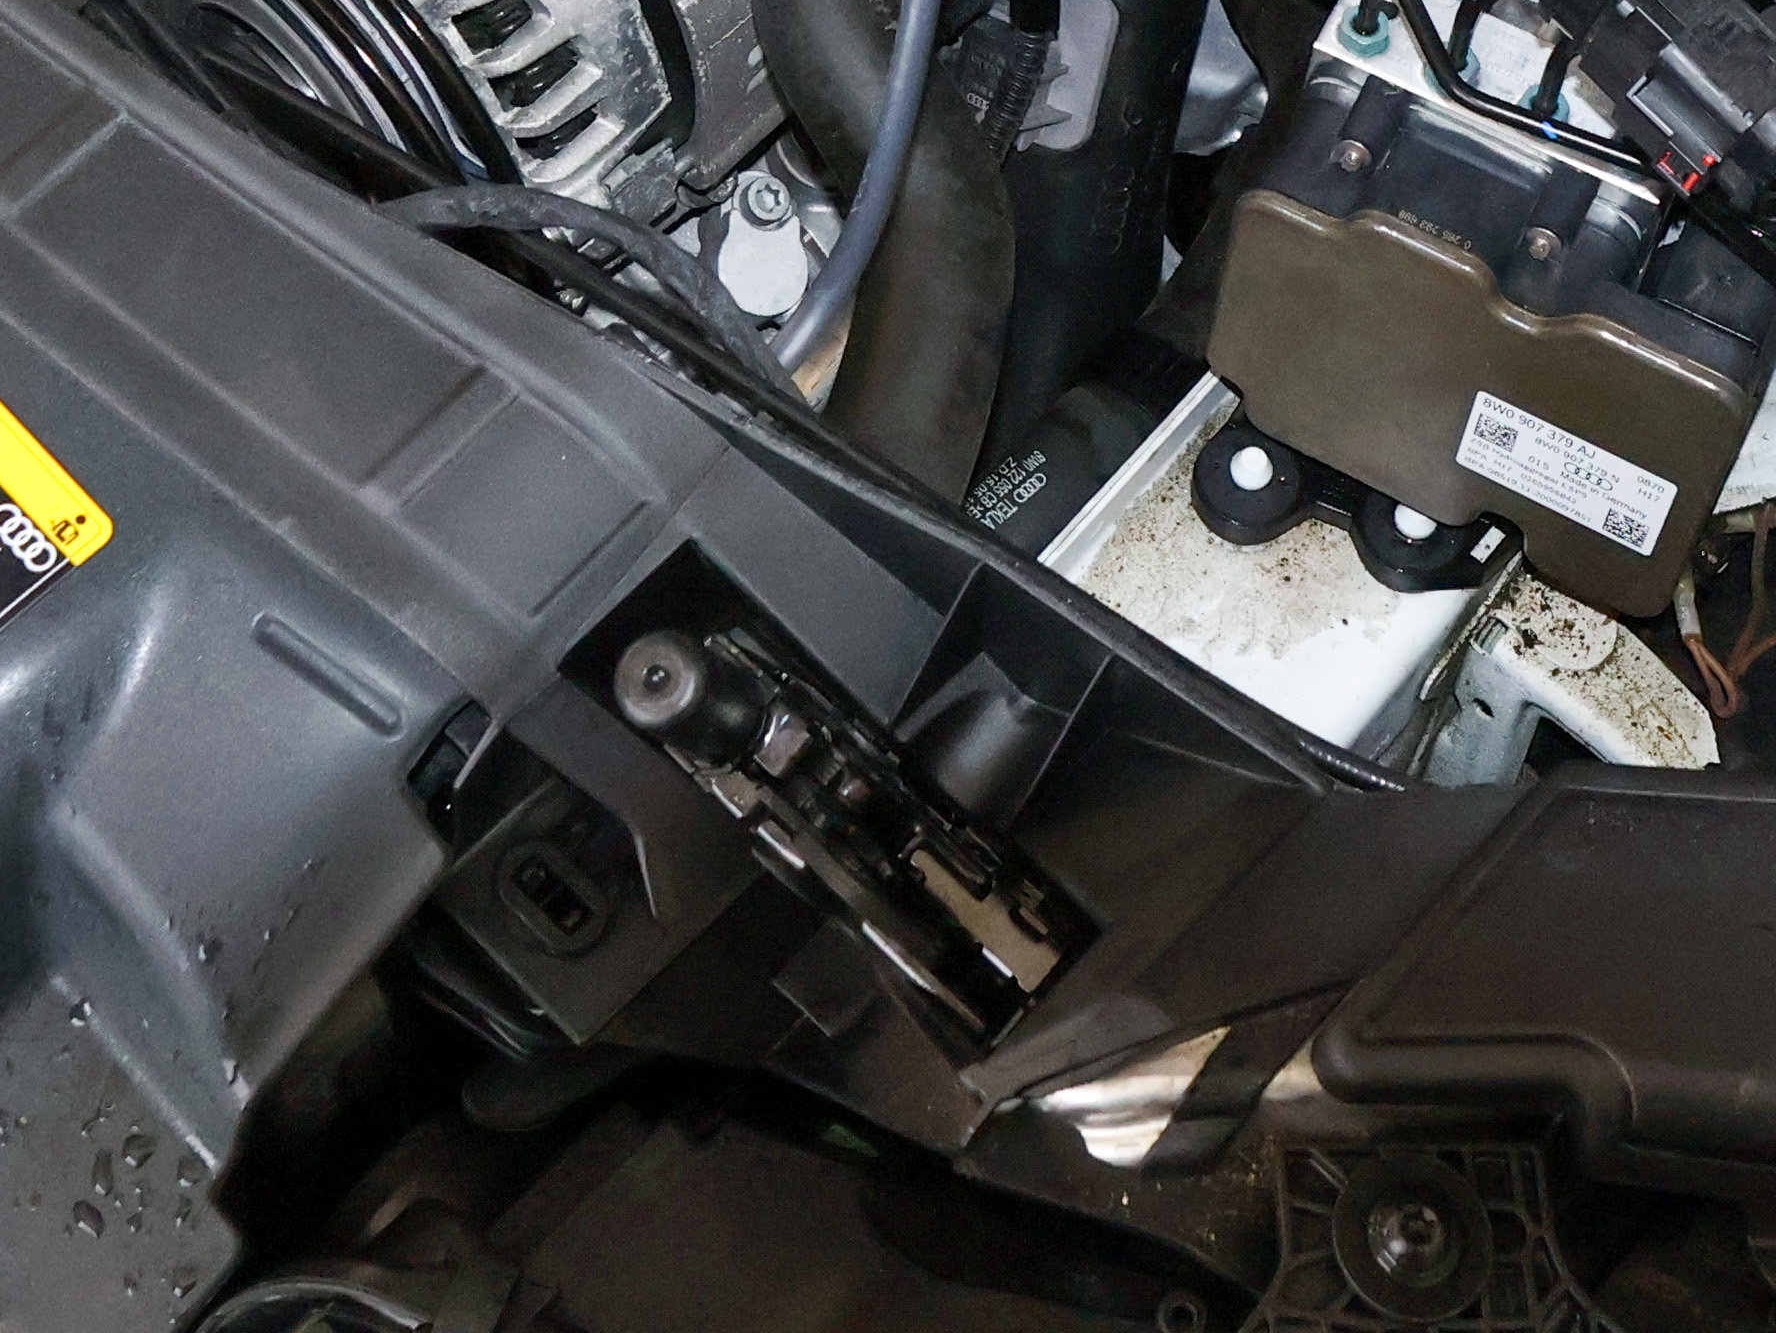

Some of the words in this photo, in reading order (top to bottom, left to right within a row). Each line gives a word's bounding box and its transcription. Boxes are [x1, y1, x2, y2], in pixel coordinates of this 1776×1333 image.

[1462, 238, 1472, 250] 0
[1481, 396, 1515, 419] 8W0
[1517, 414, 1545, 433] 907
[1546, 429, 1574, 448] 379
[1575, 444, 1596, 459] AJ
[1022, 449, 1046, 472] 8W0
[1533, 436, 1560, 454] 8W0
[1562, 449, 1585, 465] 907
[1586, 461, 1608, 477] 379
[1610, 473, 1620, 484] N
[1005, 466, 1026, 485] 122
[979, 490, 998, 508] CB
[992, 477, 1013, 498] 055
[1559, 470, 1588, 489] Made
[1588, 485, 1600, 495] in
[1601, 491, 1648, 520] Germany
[979, 497, 1019, 530] TEKLA
